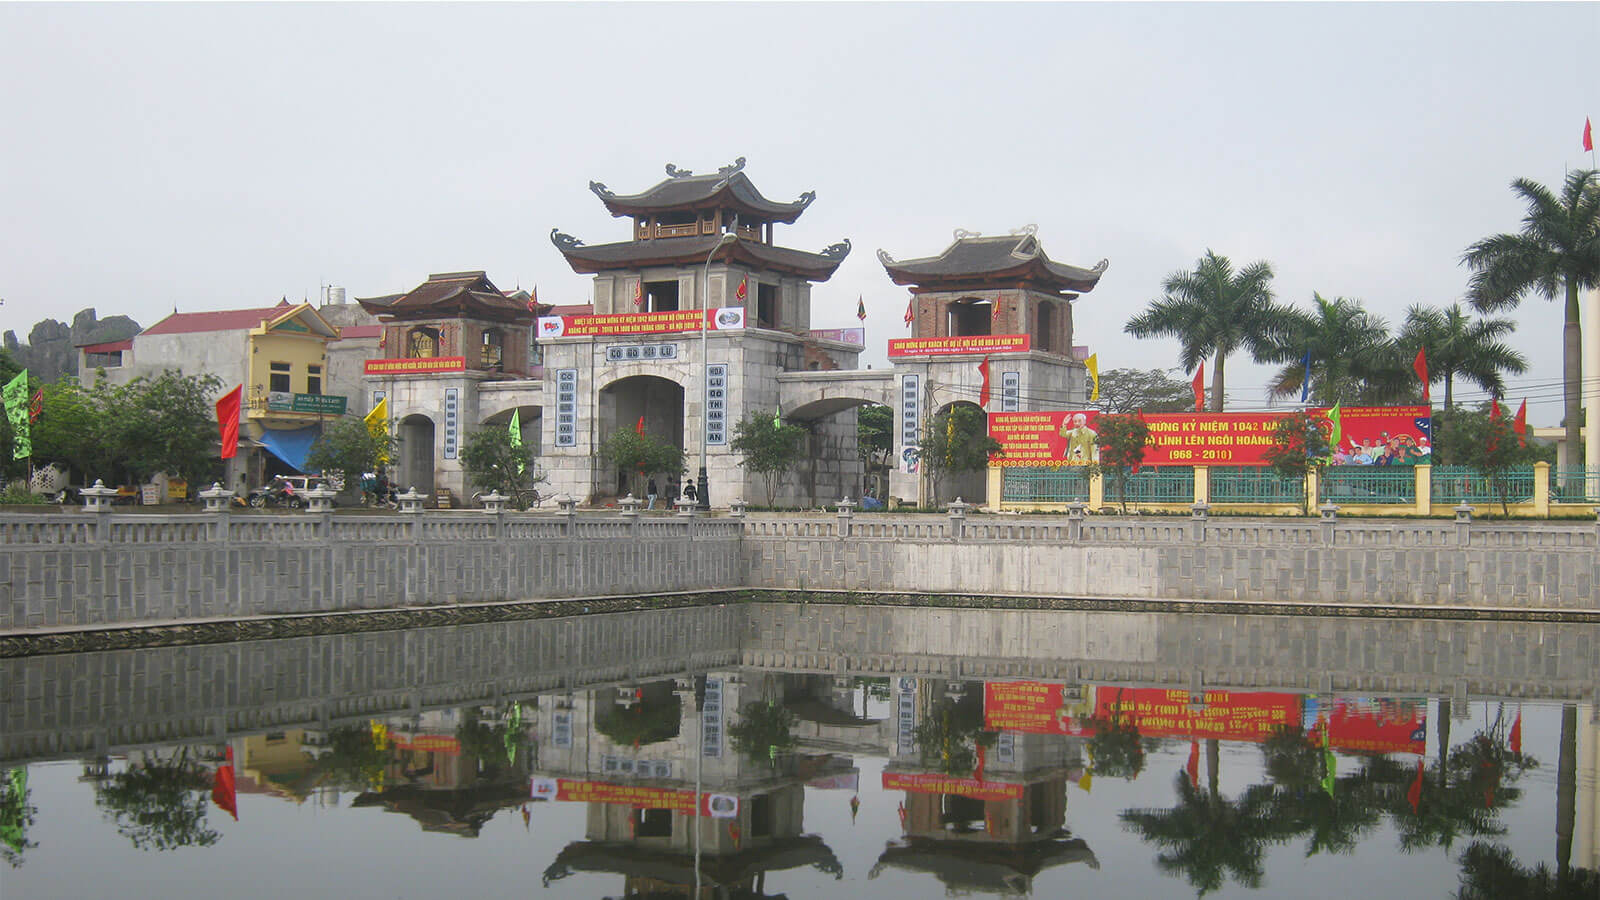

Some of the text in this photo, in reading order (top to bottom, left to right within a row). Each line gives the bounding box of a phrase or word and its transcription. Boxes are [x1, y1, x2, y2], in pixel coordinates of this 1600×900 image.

[1147, 420, 1179, 432] MỪNG
[1182, 419, 1196, 431] KỶ
[1200, 420, 1228, 433] NIỆM
[1233, 422, 1258, 431] 1042
[1159, 434, 1182, 445] LĨNH
[1185, 434, 1204, 445] LÊN
[1208, 435, 1232, 445] NGÔI
[1236, 434, 1273, 445] HOÀNG
[1169, 450, 1192, 460] (968
[1203, 450, 1232, 460] 2010)
